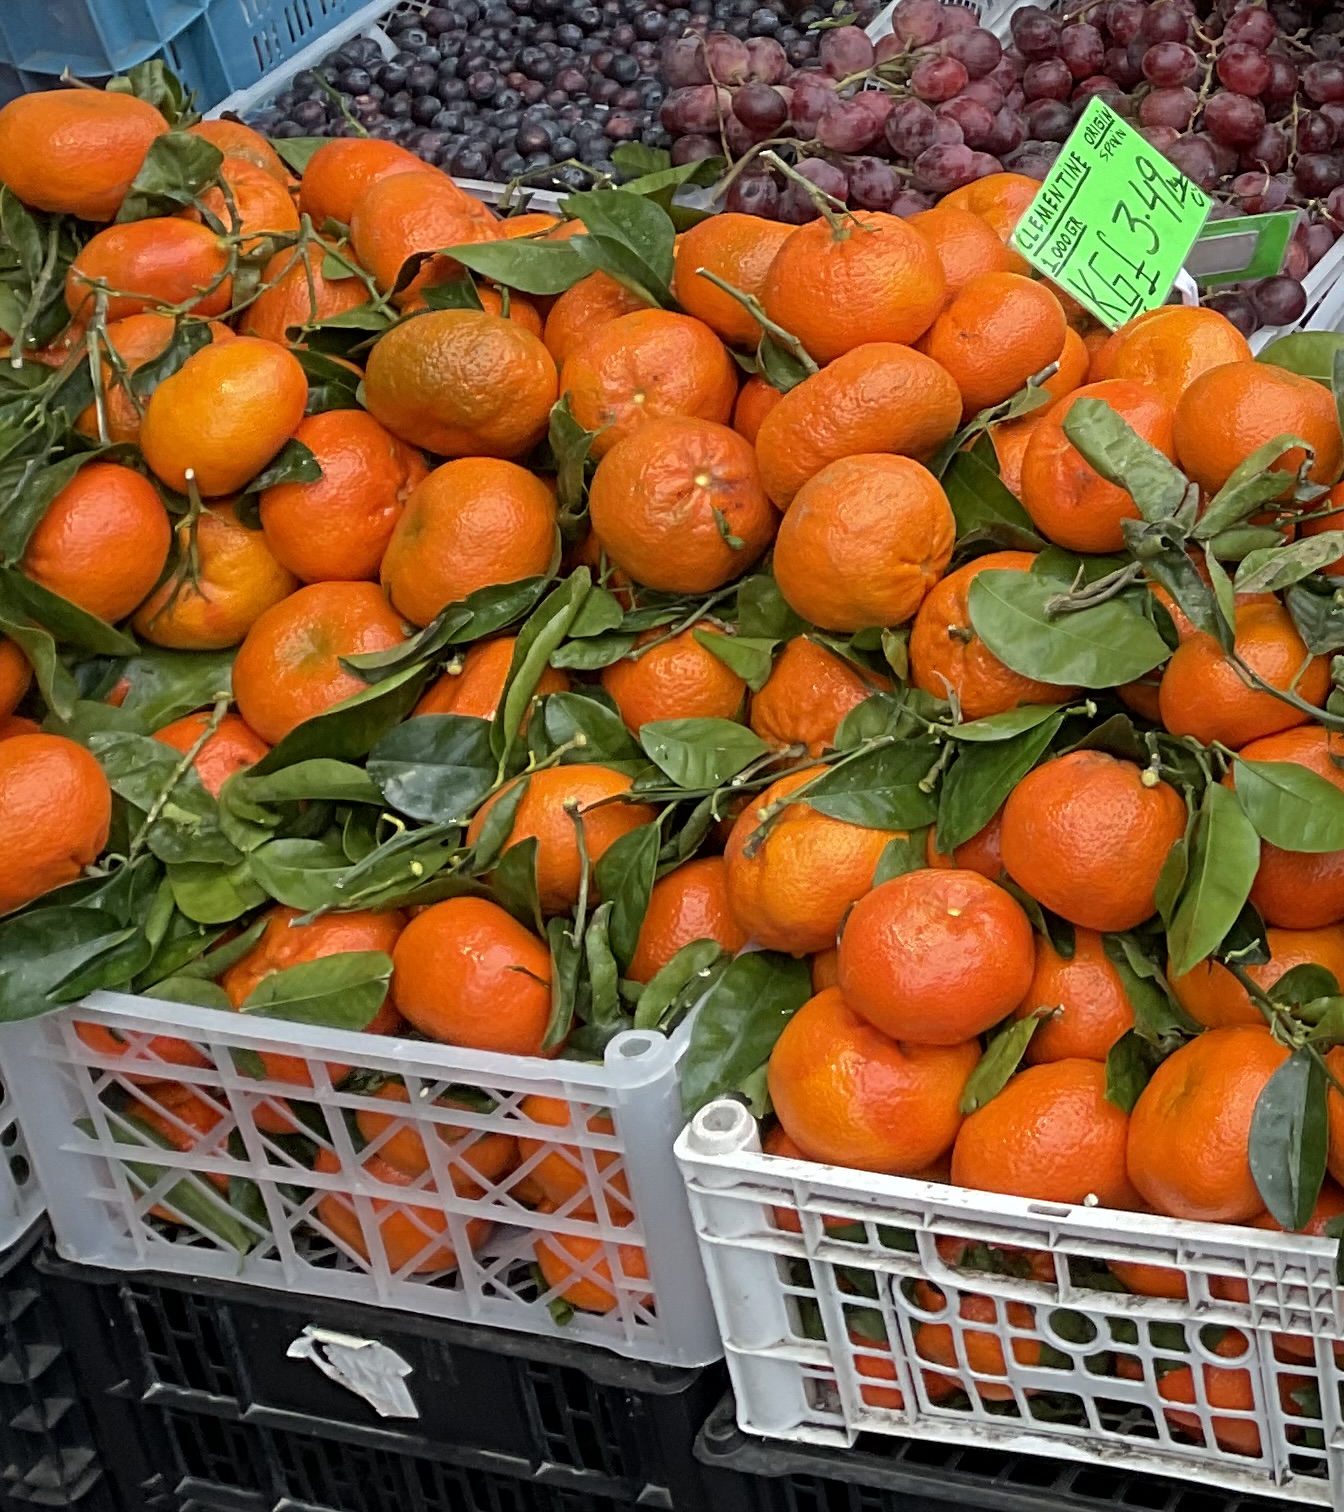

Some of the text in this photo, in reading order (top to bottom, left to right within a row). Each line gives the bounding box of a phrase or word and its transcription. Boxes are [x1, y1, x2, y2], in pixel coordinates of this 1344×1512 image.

[1083, 105, 1114, 146] ORIGIN
[1099, 128, 1128, 163] SPAIN
[1017, 151, 1089, 251] CLEMENTINE
[1067, 250, 1143, 324] KG
